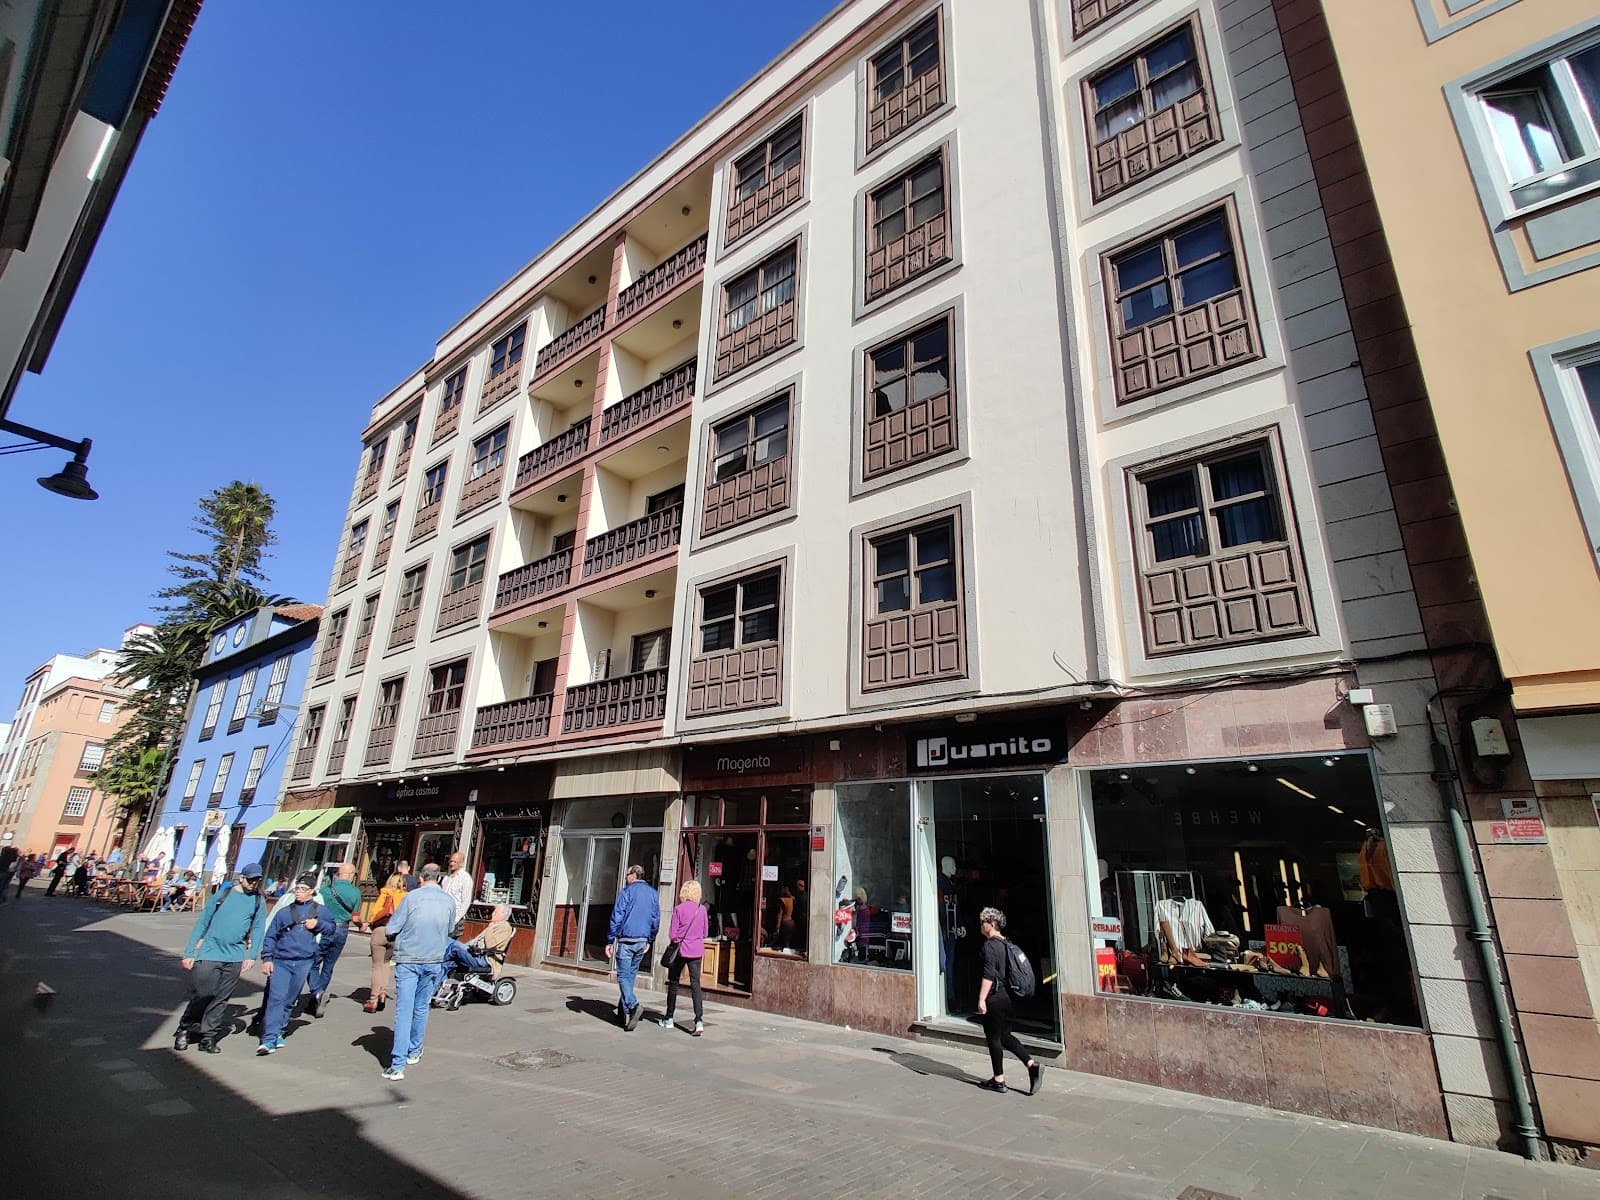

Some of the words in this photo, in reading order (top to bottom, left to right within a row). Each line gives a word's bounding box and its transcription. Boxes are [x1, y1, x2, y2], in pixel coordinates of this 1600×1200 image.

[916, 737, 1052, 767] Juanito
[717, 755, 771, 773] Magenta
[415, 786, 439, 796] cosmos
[1092, 923, 1121, 934] REBAJAS
[1269, 941, 1301, 955] 50%
[1098, 963, 1117, 977] 50%
